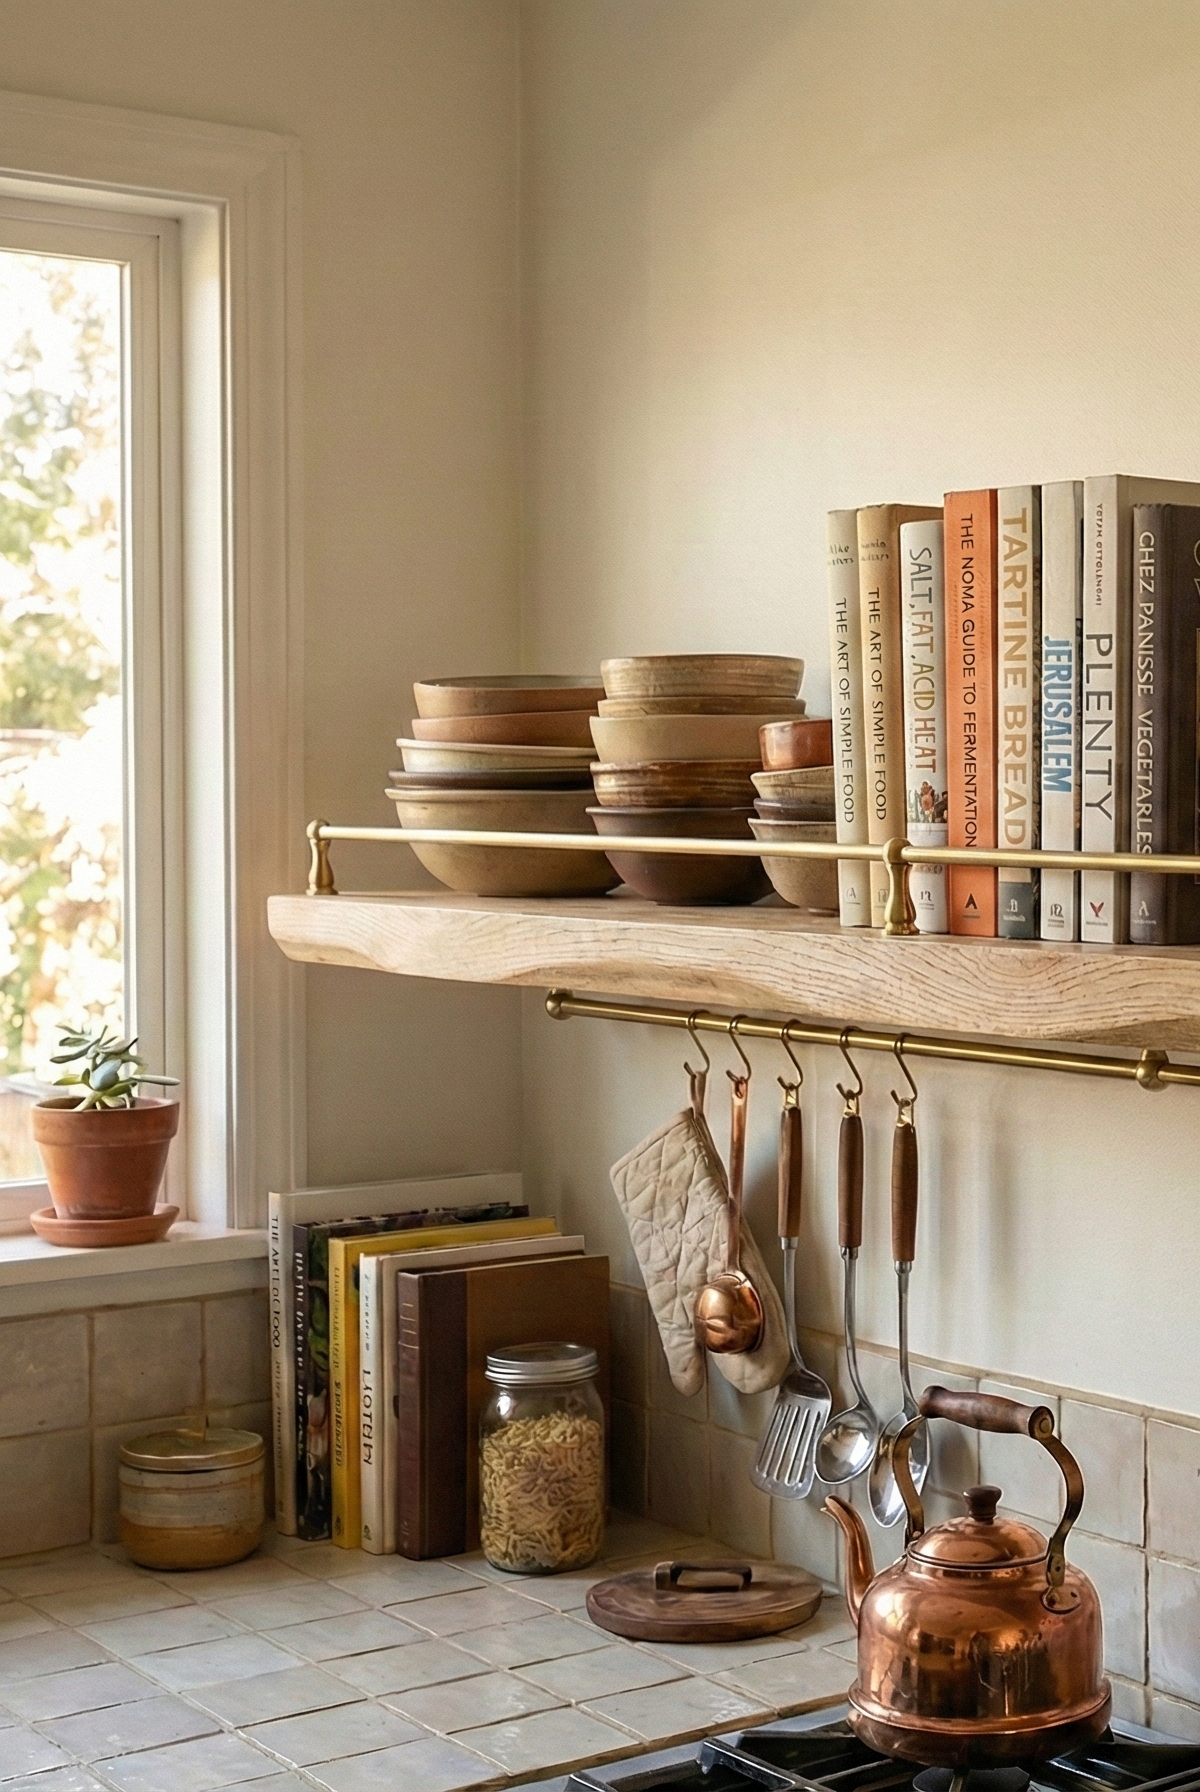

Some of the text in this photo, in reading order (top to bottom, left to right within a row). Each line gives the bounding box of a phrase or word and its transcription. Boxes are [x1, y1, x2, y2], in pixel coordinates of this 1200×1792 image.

[909, 547, 933, 609] SALT,
[1139, 531, 1155, 594] CHEZ
[835, 598, 855, 823] THE ART OF SIMPLE FOOD
[868, 587, 887, 821] THE ART OF SIMPLE FOOD
[912, 662, 935, 711] ACID
[960, 513, 978, 847] THE NOMA GUIDE TO FERMENTATION
[1002, 507, 1028, 845] TARTINE BREAD
[1042, 635, 1073, 793] JERUSALEM
[1085, 633, 1113, 821] PLENTY
[1136, 602, 1154, 697] PANISSE
[914, 717, 937, 774] HEAT
